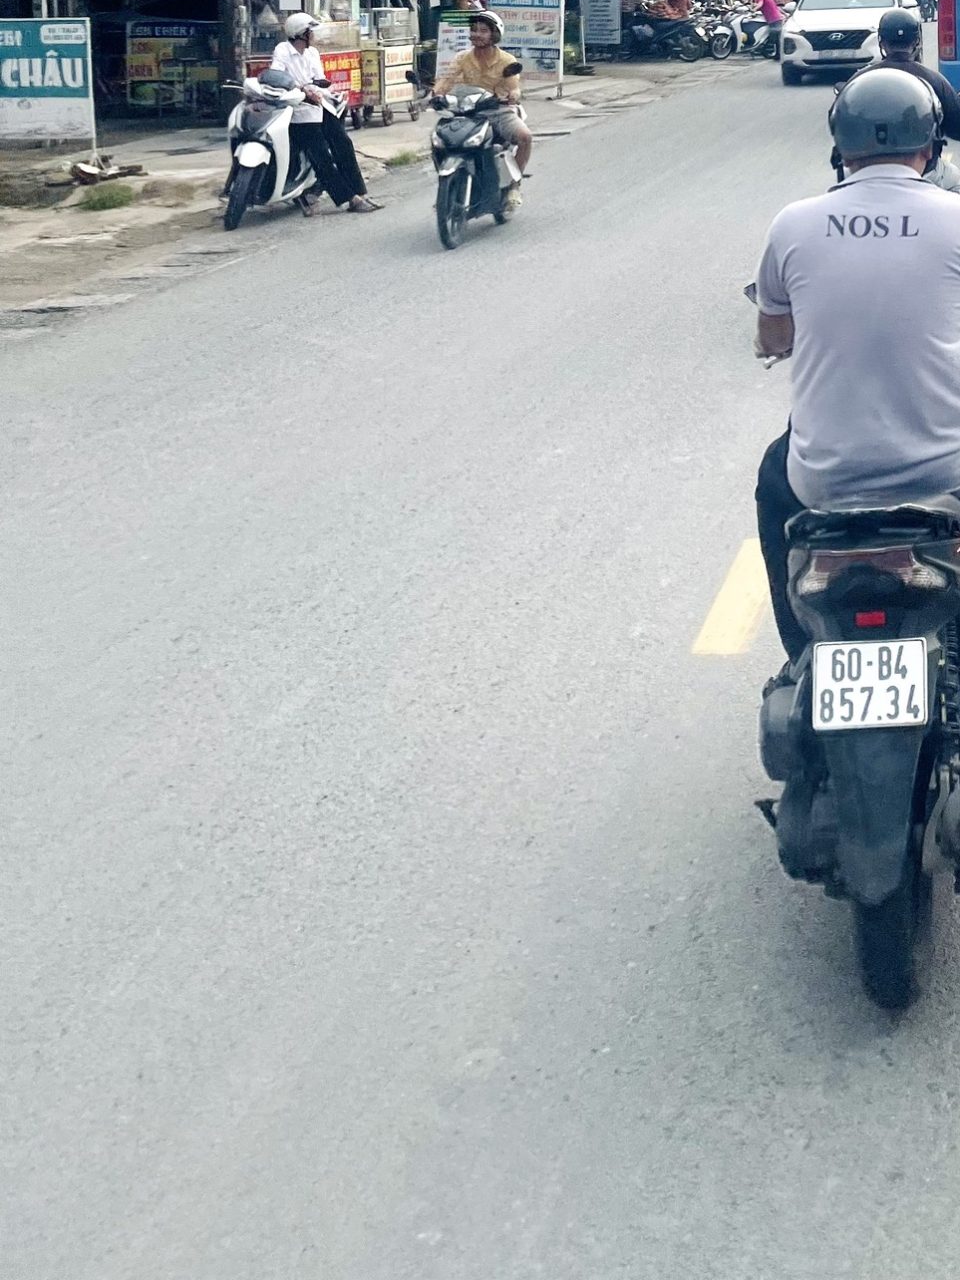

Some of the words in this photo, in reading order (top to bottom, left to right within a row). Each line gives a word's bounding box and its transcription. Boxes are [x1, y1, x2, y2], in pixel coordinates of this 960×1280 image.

[1, 49, 84, 88] CHÂU
[831, 644, 908, 683] 60-B4
[819, 683, 921, 724] 857.34
